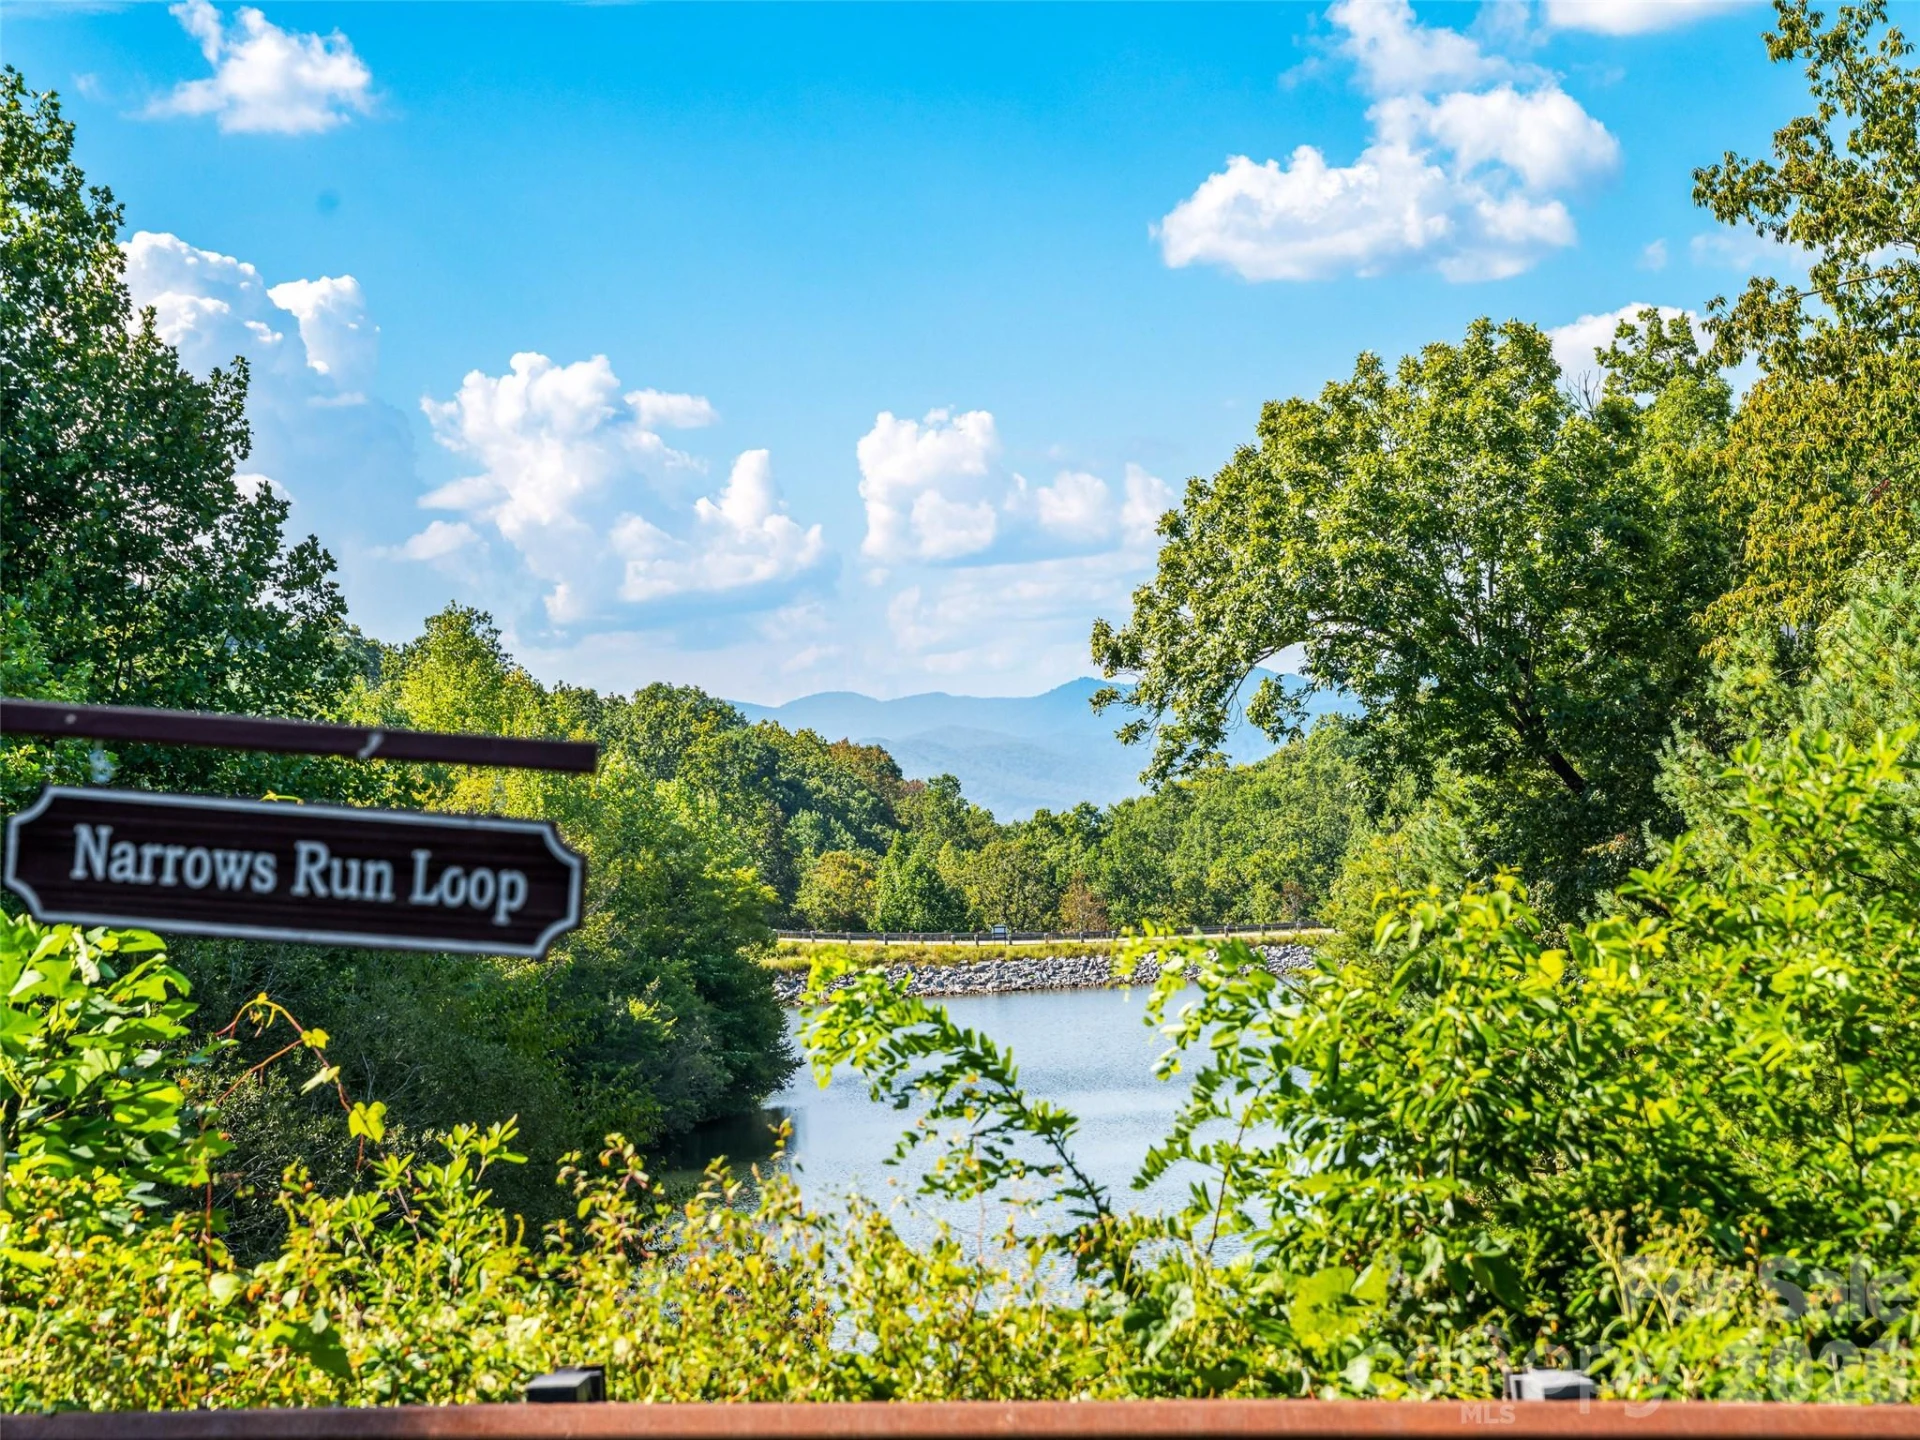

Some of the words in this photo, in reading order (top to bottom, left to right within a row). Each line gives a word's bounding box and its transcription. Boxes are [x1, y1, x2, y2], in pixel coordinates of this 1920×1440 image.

[70, 823, 278, 894] Narrows
[290, 839, 396, 901] Run
[409, 848, 529, 926] Loop
